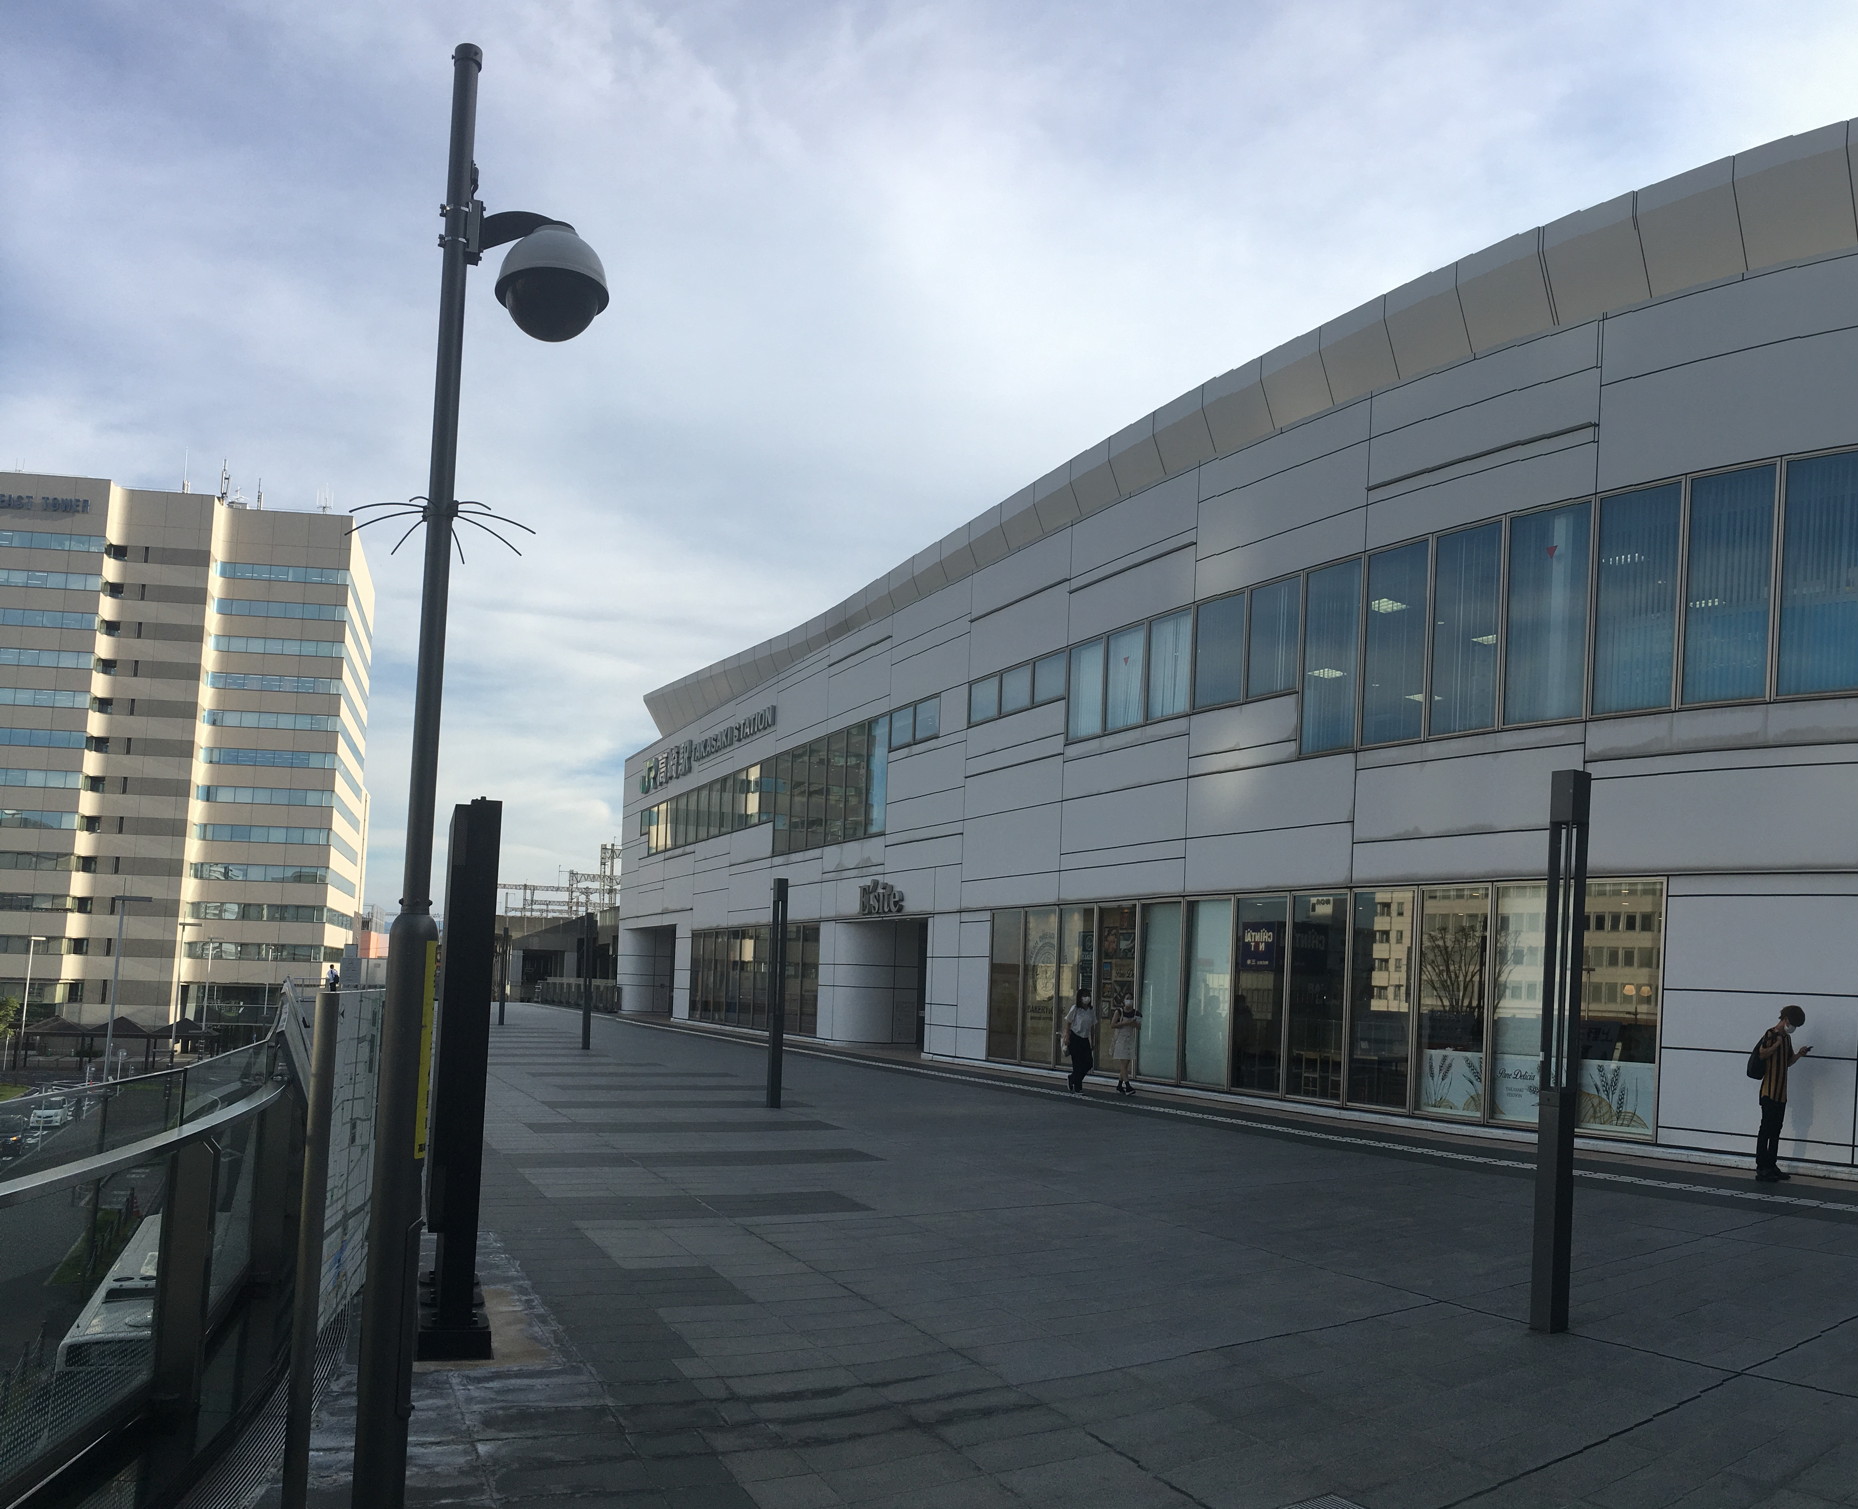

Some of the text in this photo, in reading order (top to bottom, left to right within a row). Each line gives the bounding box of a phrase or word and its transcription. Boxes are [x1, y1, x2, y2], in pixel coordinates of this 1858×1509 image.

[41, 496, 91, 514] TOWER
[639, 756, 659, 795] JR
[691, 725, 735, 762] TAKASAKI
[733, 704, 777, 743] STATION
